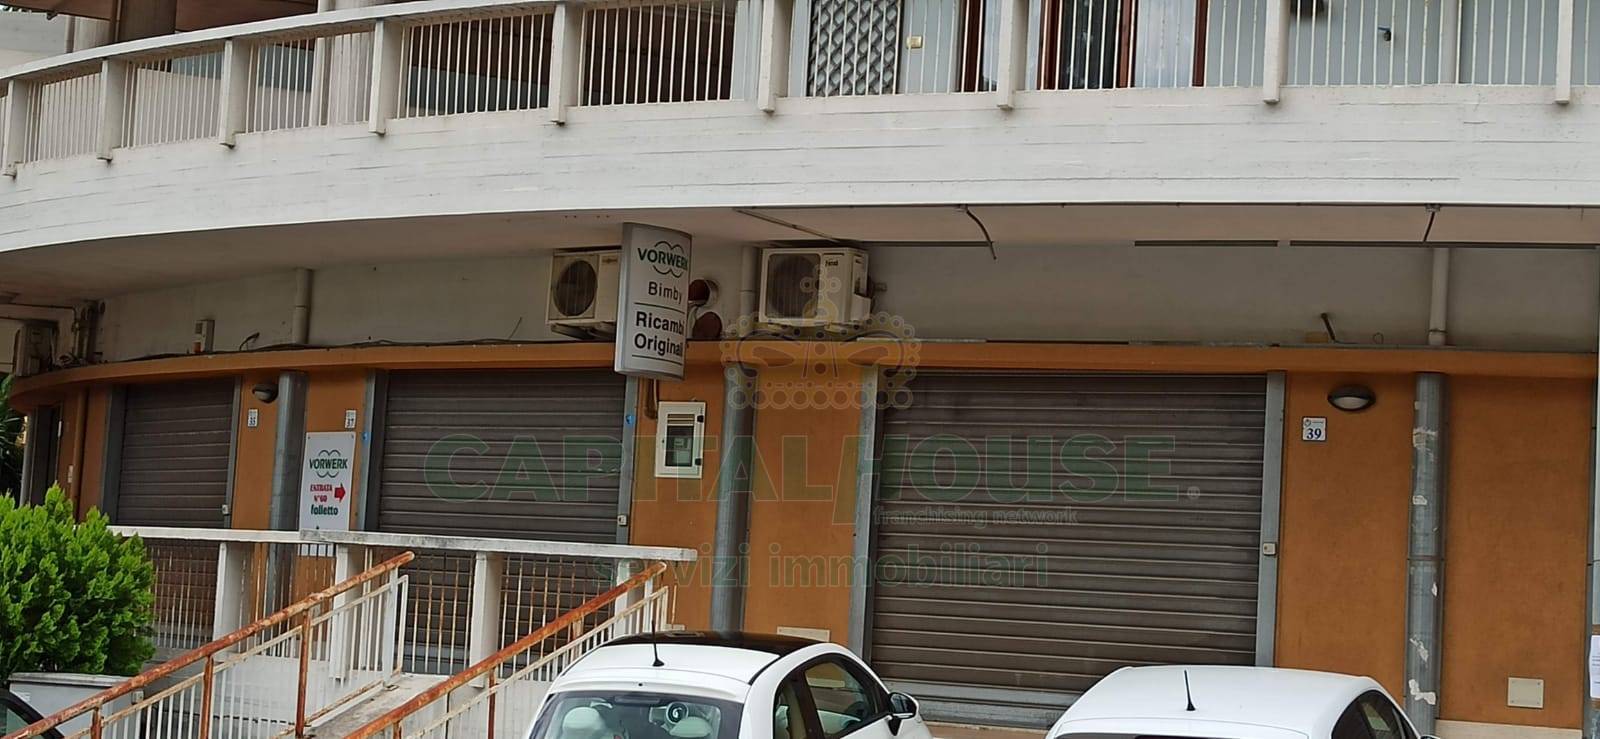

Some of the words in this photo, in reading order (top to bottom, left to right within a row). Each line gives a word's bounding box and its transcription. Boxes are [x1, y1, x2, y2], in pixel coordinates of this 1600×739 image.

[648, 281, 683, 304] Bimby
[1306, 428, 1322, 439] 39
[309, 458, 348, 470] VORWERK
[310, 504, 338, 515] folletto
